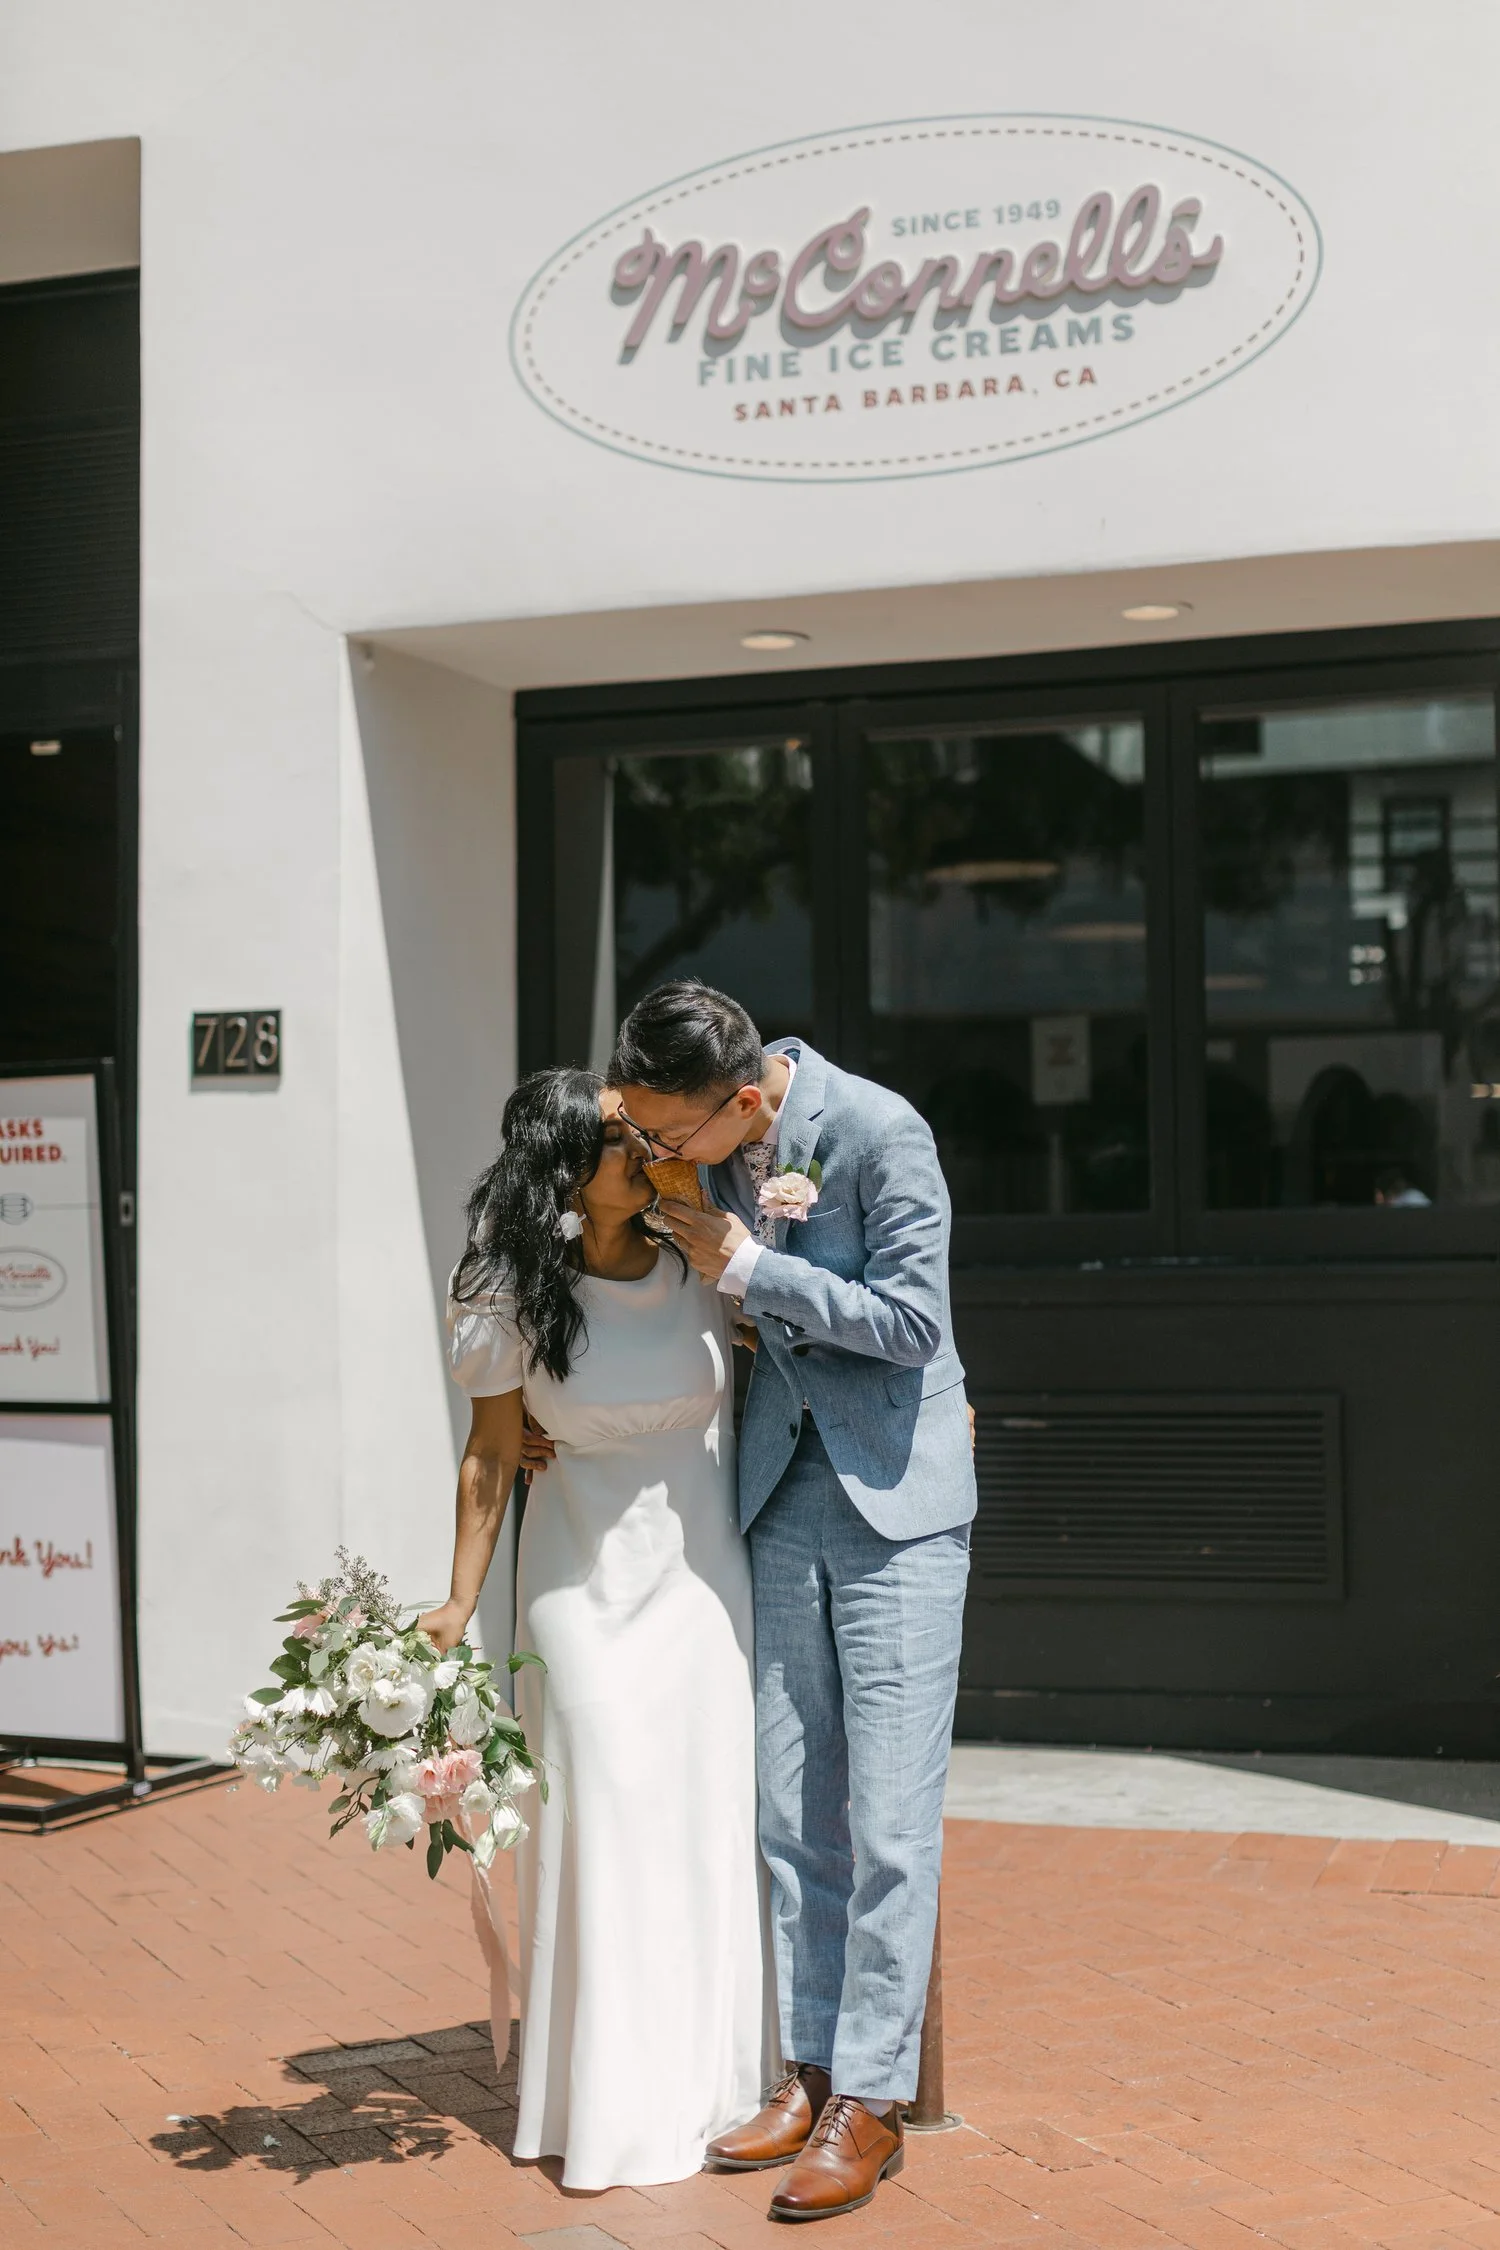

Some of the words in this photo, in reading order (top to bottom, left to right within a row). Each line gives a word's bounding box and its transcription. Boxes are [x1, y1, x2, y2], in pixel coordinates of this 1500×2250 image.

[892, 209, 981, 237] SINCE
[993, 199, 1061, 225] 1949
[698, 351, 802, 386] FINE
[829, 340, 904, 372] ICE
[930, 313, 1135, 361] CREAMS
[734, 393, 842, 421] SANTA
[1054, 366, 1097, 388] CA
[195, 1015, 278, 1068] 728
